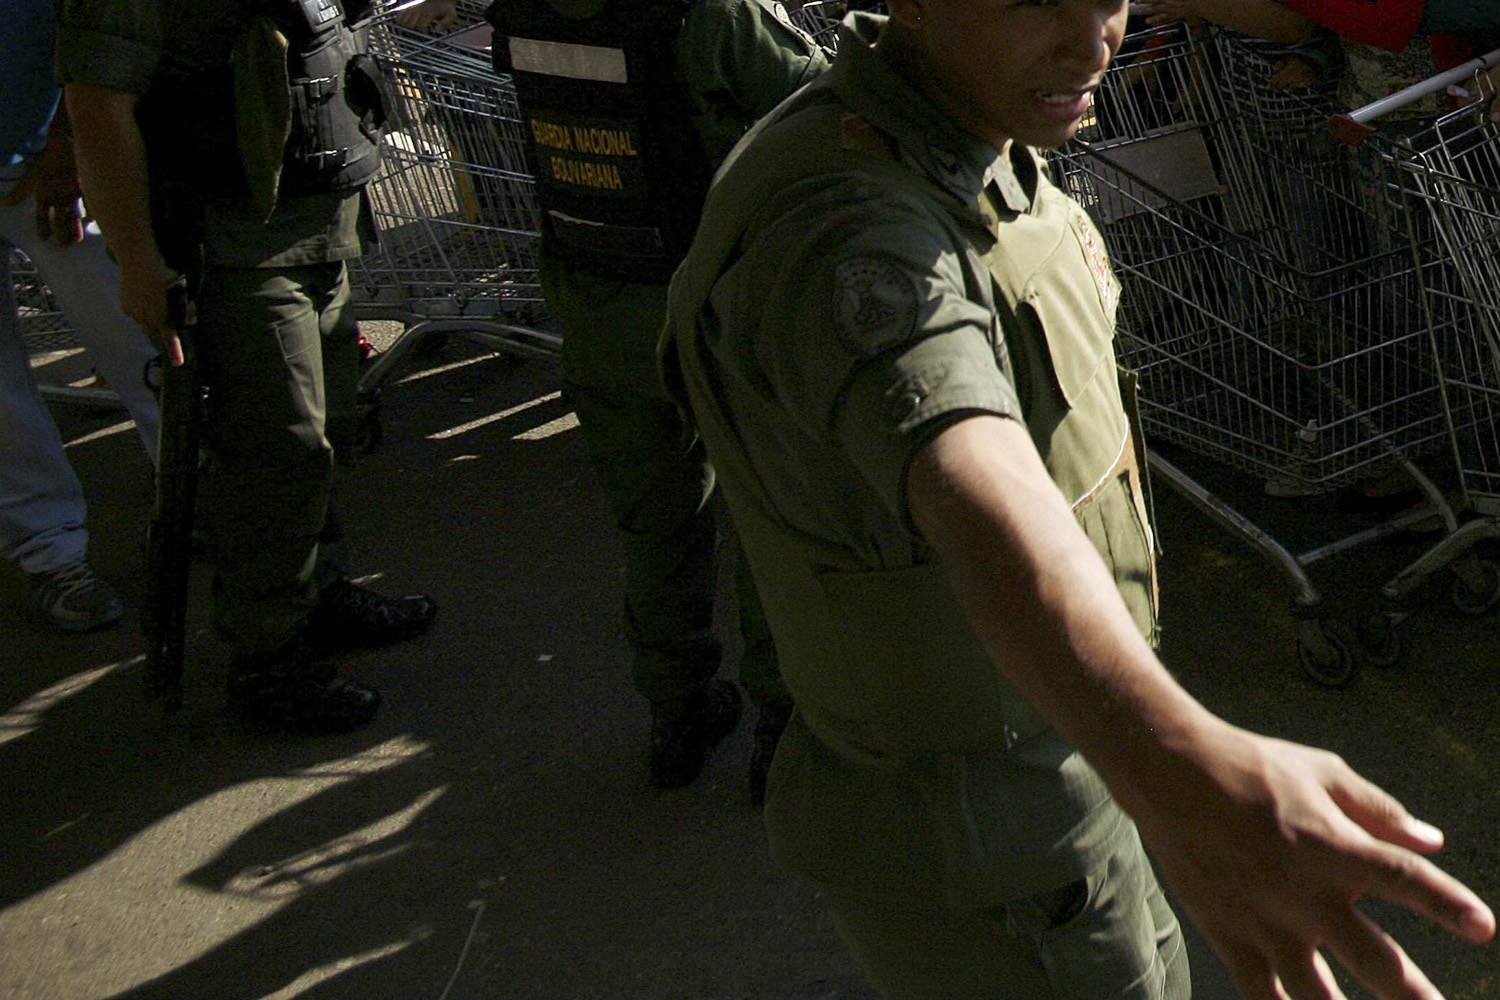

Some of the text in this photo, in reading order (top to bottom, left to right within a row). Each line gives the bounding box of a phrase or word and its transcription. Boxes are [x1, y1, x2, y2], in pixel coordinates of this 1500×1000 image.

[531, 119, 638, 156] GUARDIA NACIONAL
[550, 156, 624, 190] BOLIVARIANA
